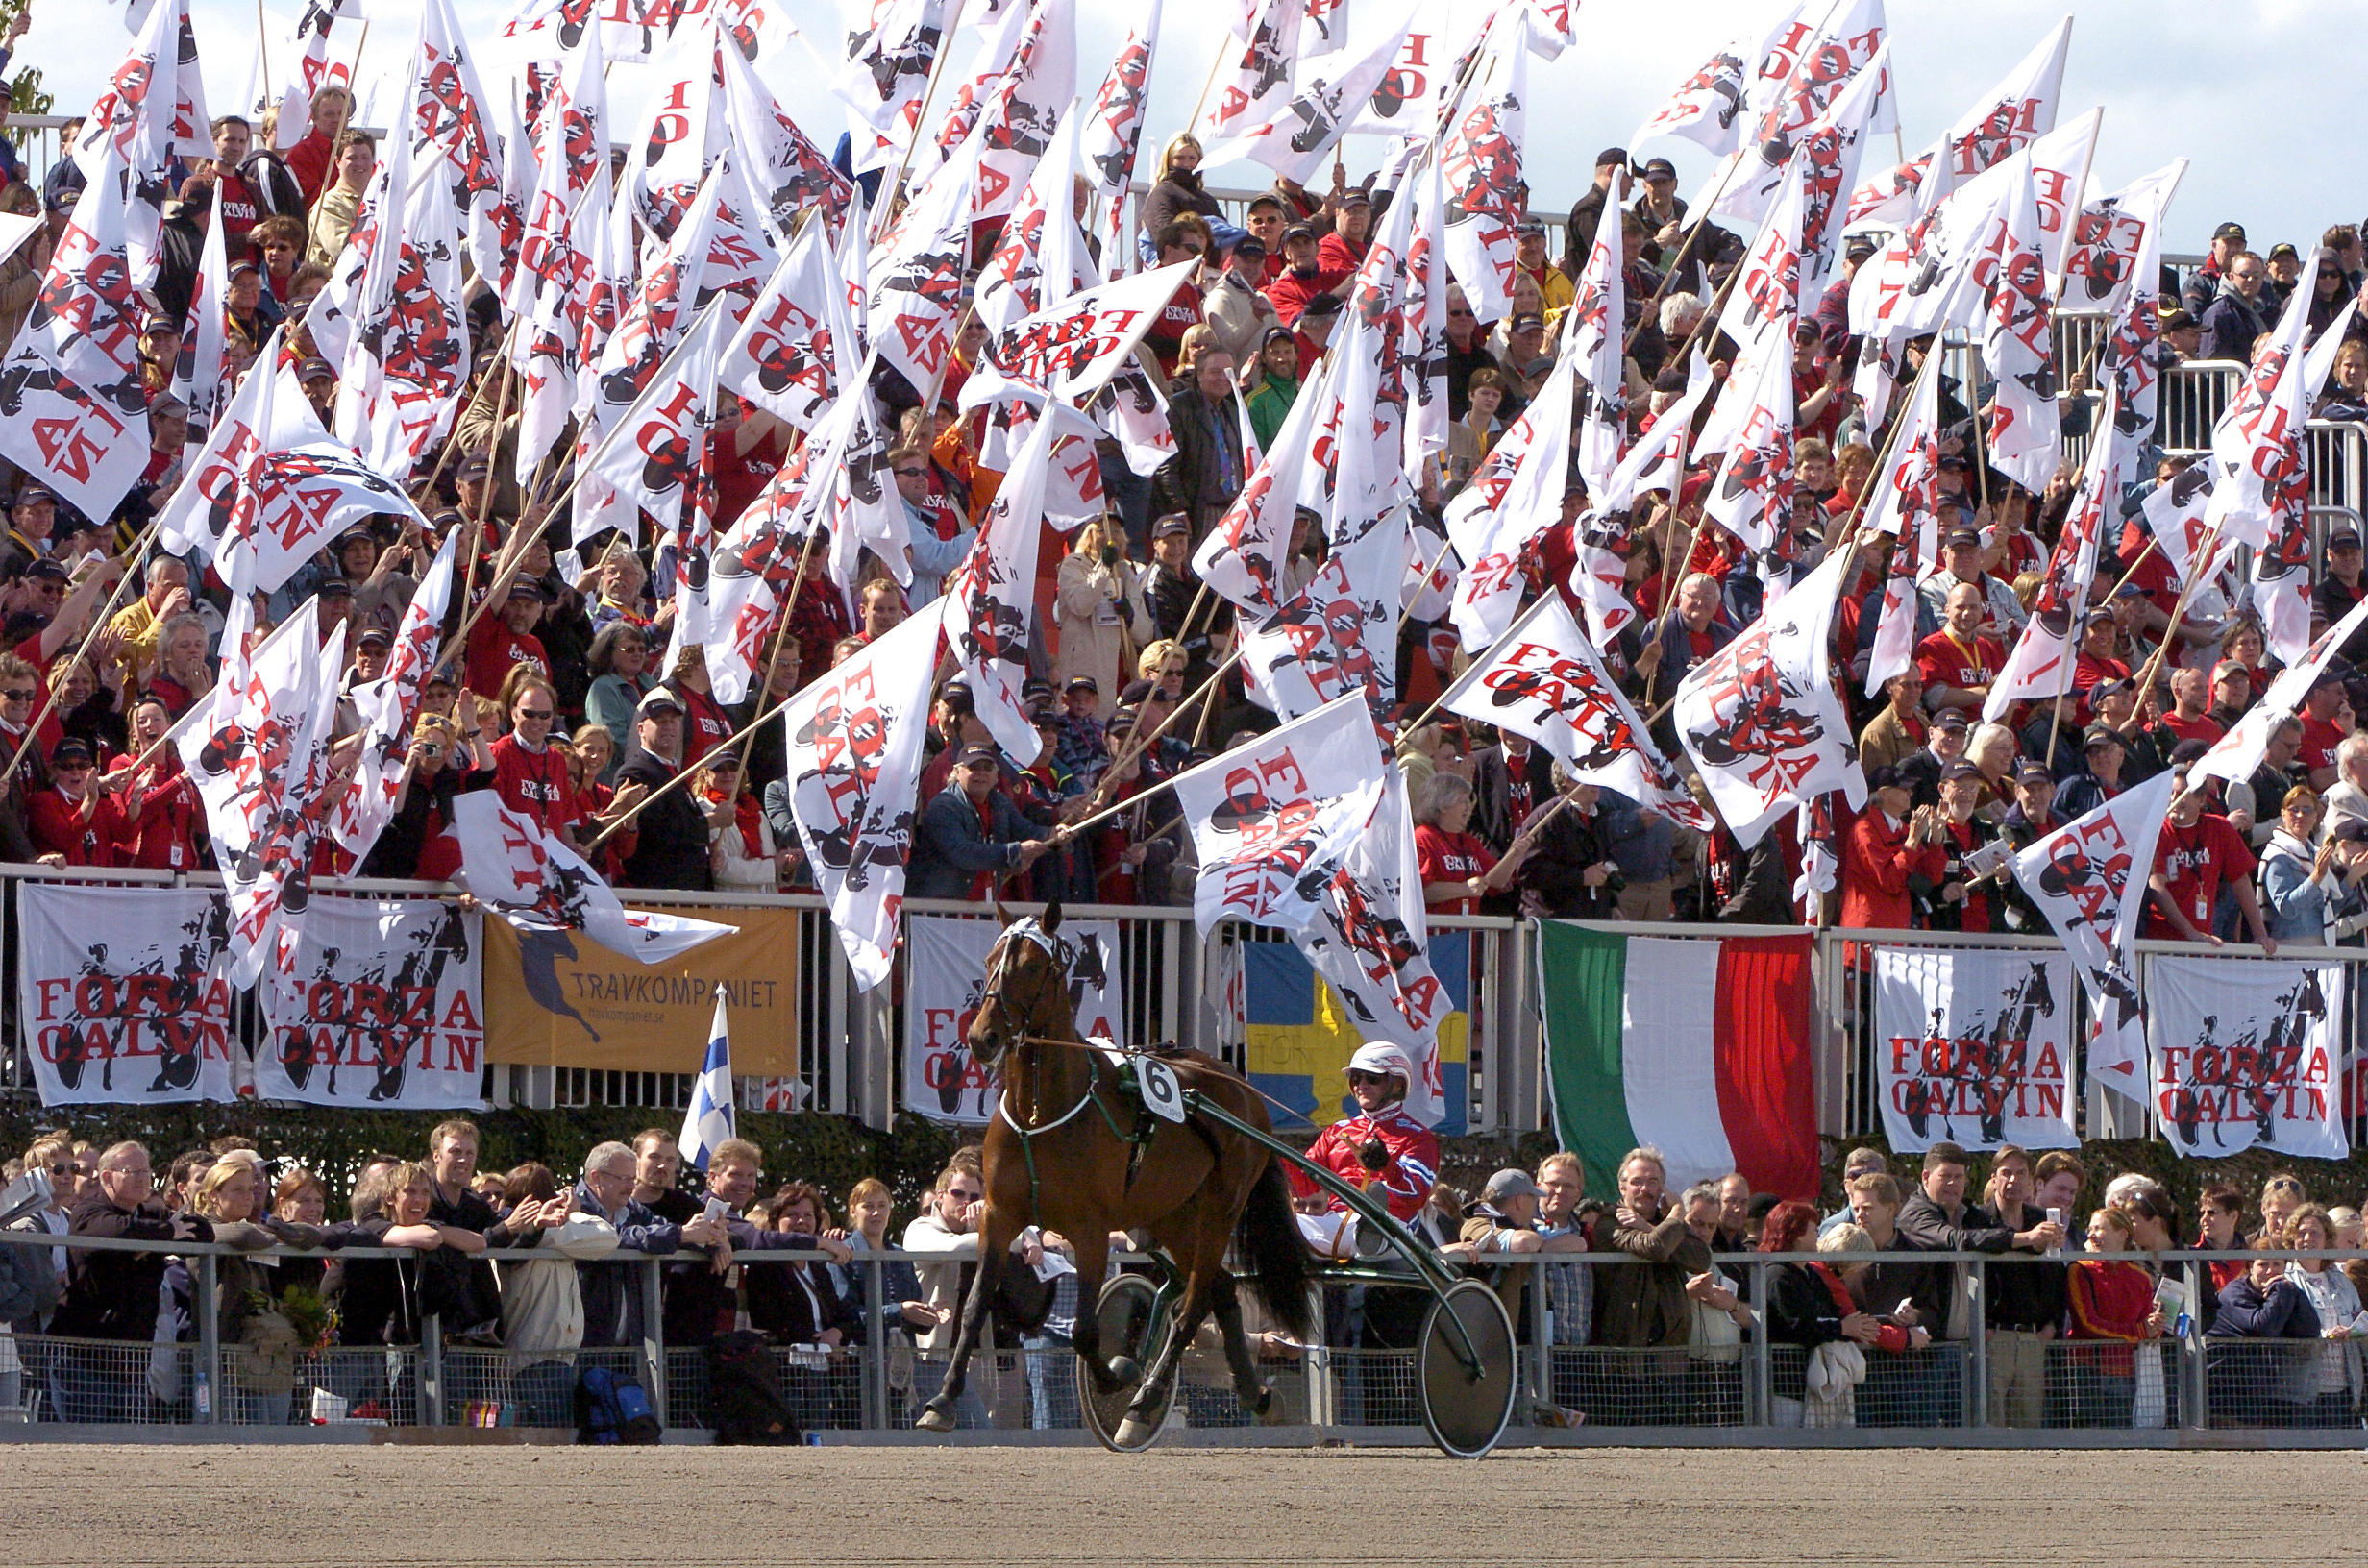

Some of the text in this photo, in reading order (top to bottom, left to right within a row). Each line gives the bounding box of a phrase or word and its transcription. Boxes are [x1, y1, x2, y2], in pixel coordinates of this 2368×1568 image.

[571, 972, 777, 1009] TRAVKOMPANIET
[37, 1017, 231, 1066] CALVN
[273, 1024, 482, 1073] CALVIN
[1888, 1039, 2064, 1079] FORZA
[1146, 1061, 1173, 1104] 6
[2159, 1047, 2329, 1084] FORZA
[1891, 1078, 2065, 1118] CALVIN
[2159, 1087, 2328, 1123] CALVIN
